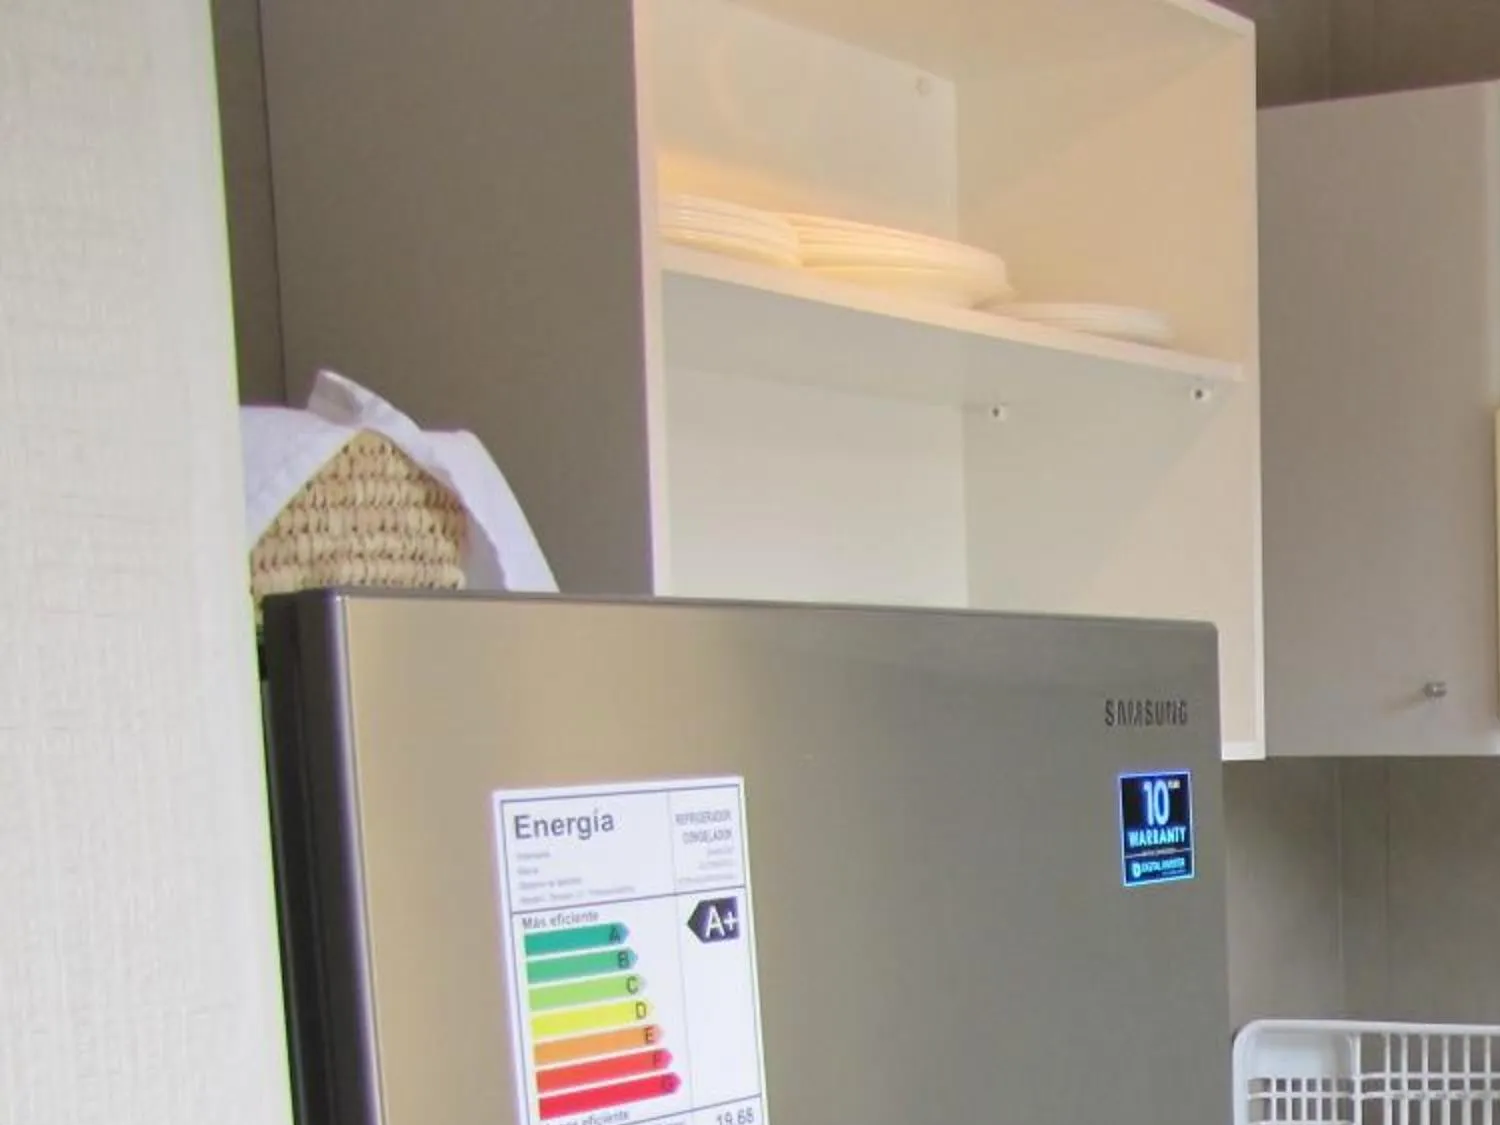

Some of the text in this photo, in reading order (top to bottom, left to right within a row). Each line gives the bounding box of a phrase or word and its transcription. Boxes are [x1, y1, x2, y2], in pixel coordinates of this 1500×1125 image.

[1104, 698, 1189, 728] SAMSUNG
[1142, 779, 1171, 826] 10
[513, 807, 616, 841] Energía
[1127, 826, 1187, 848] WARRANTY
[549, 911, 600, 926] eficiente
[704, 905, 738, 939] A+
[609, 927, 621, 943] A
[618, 952, 630, 969] B
[626, 976, 639, 995] C
[635, 1002, 648, 1019] D
[643, 1026, 656, 1045] E
